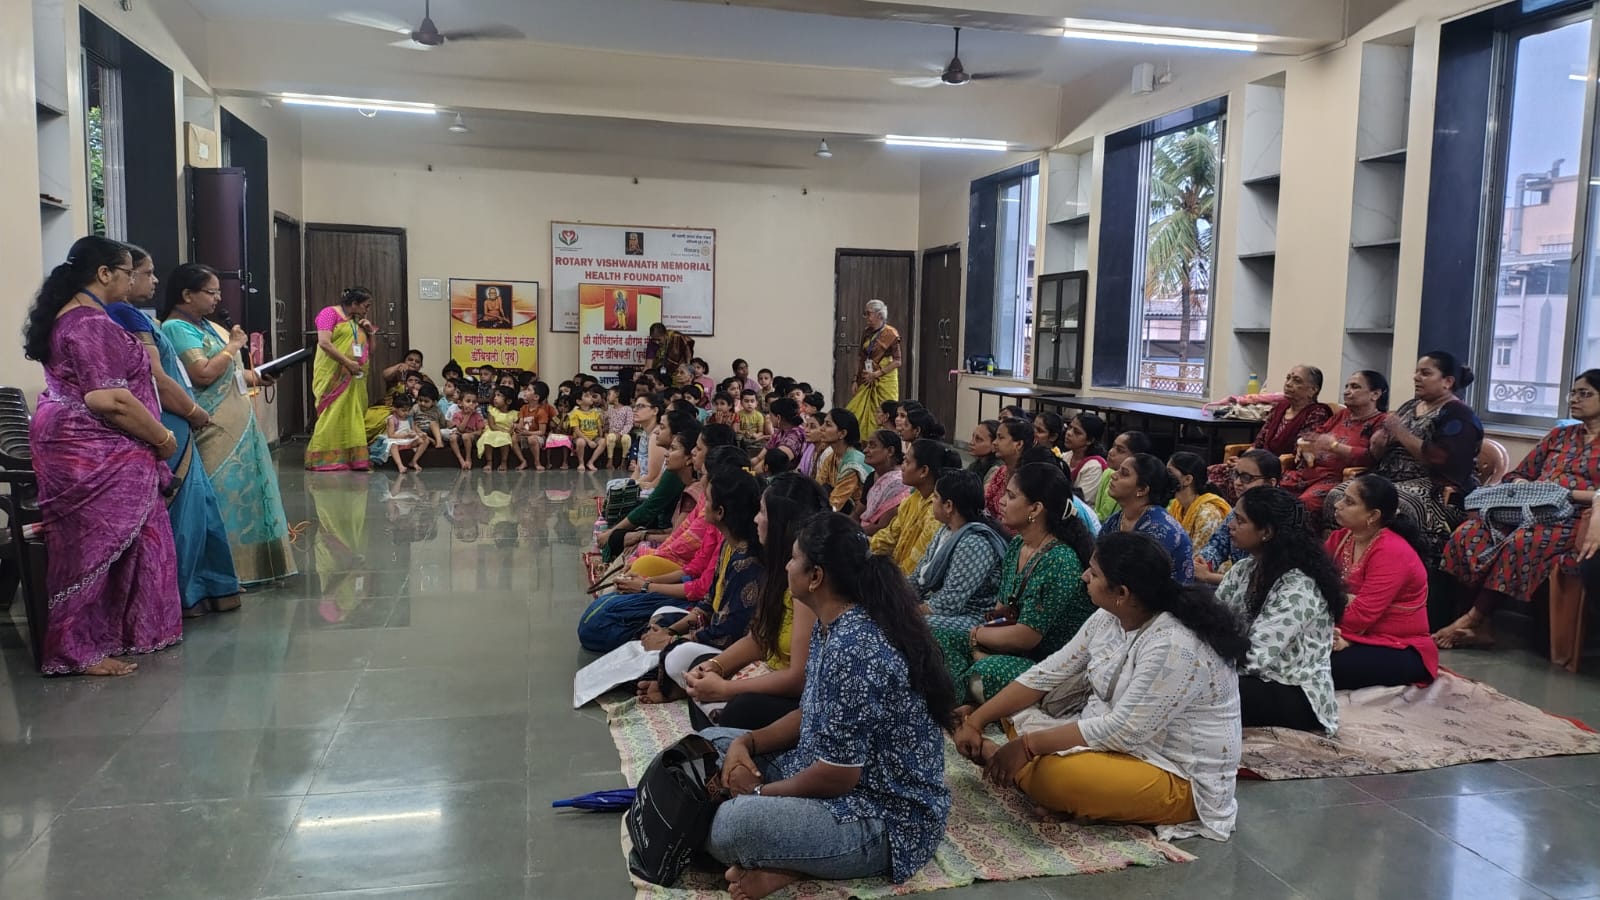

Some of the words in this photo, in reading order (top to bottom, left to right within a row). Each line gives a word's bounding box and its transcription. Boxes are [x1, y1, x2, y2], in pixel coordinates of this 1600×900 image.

[555, 257, 593, 267] ROTARY
[596, 258, 658, 269] VISHWANATH
[661, 261, 711, 271] MEMORIAL
[585, 271, 621, 281] HEALTH
[624, 273, 683, 283] FOUNDATION
[464, 332, 483, 345] स्वामी
[504, 333, 517, 346] सेवा
